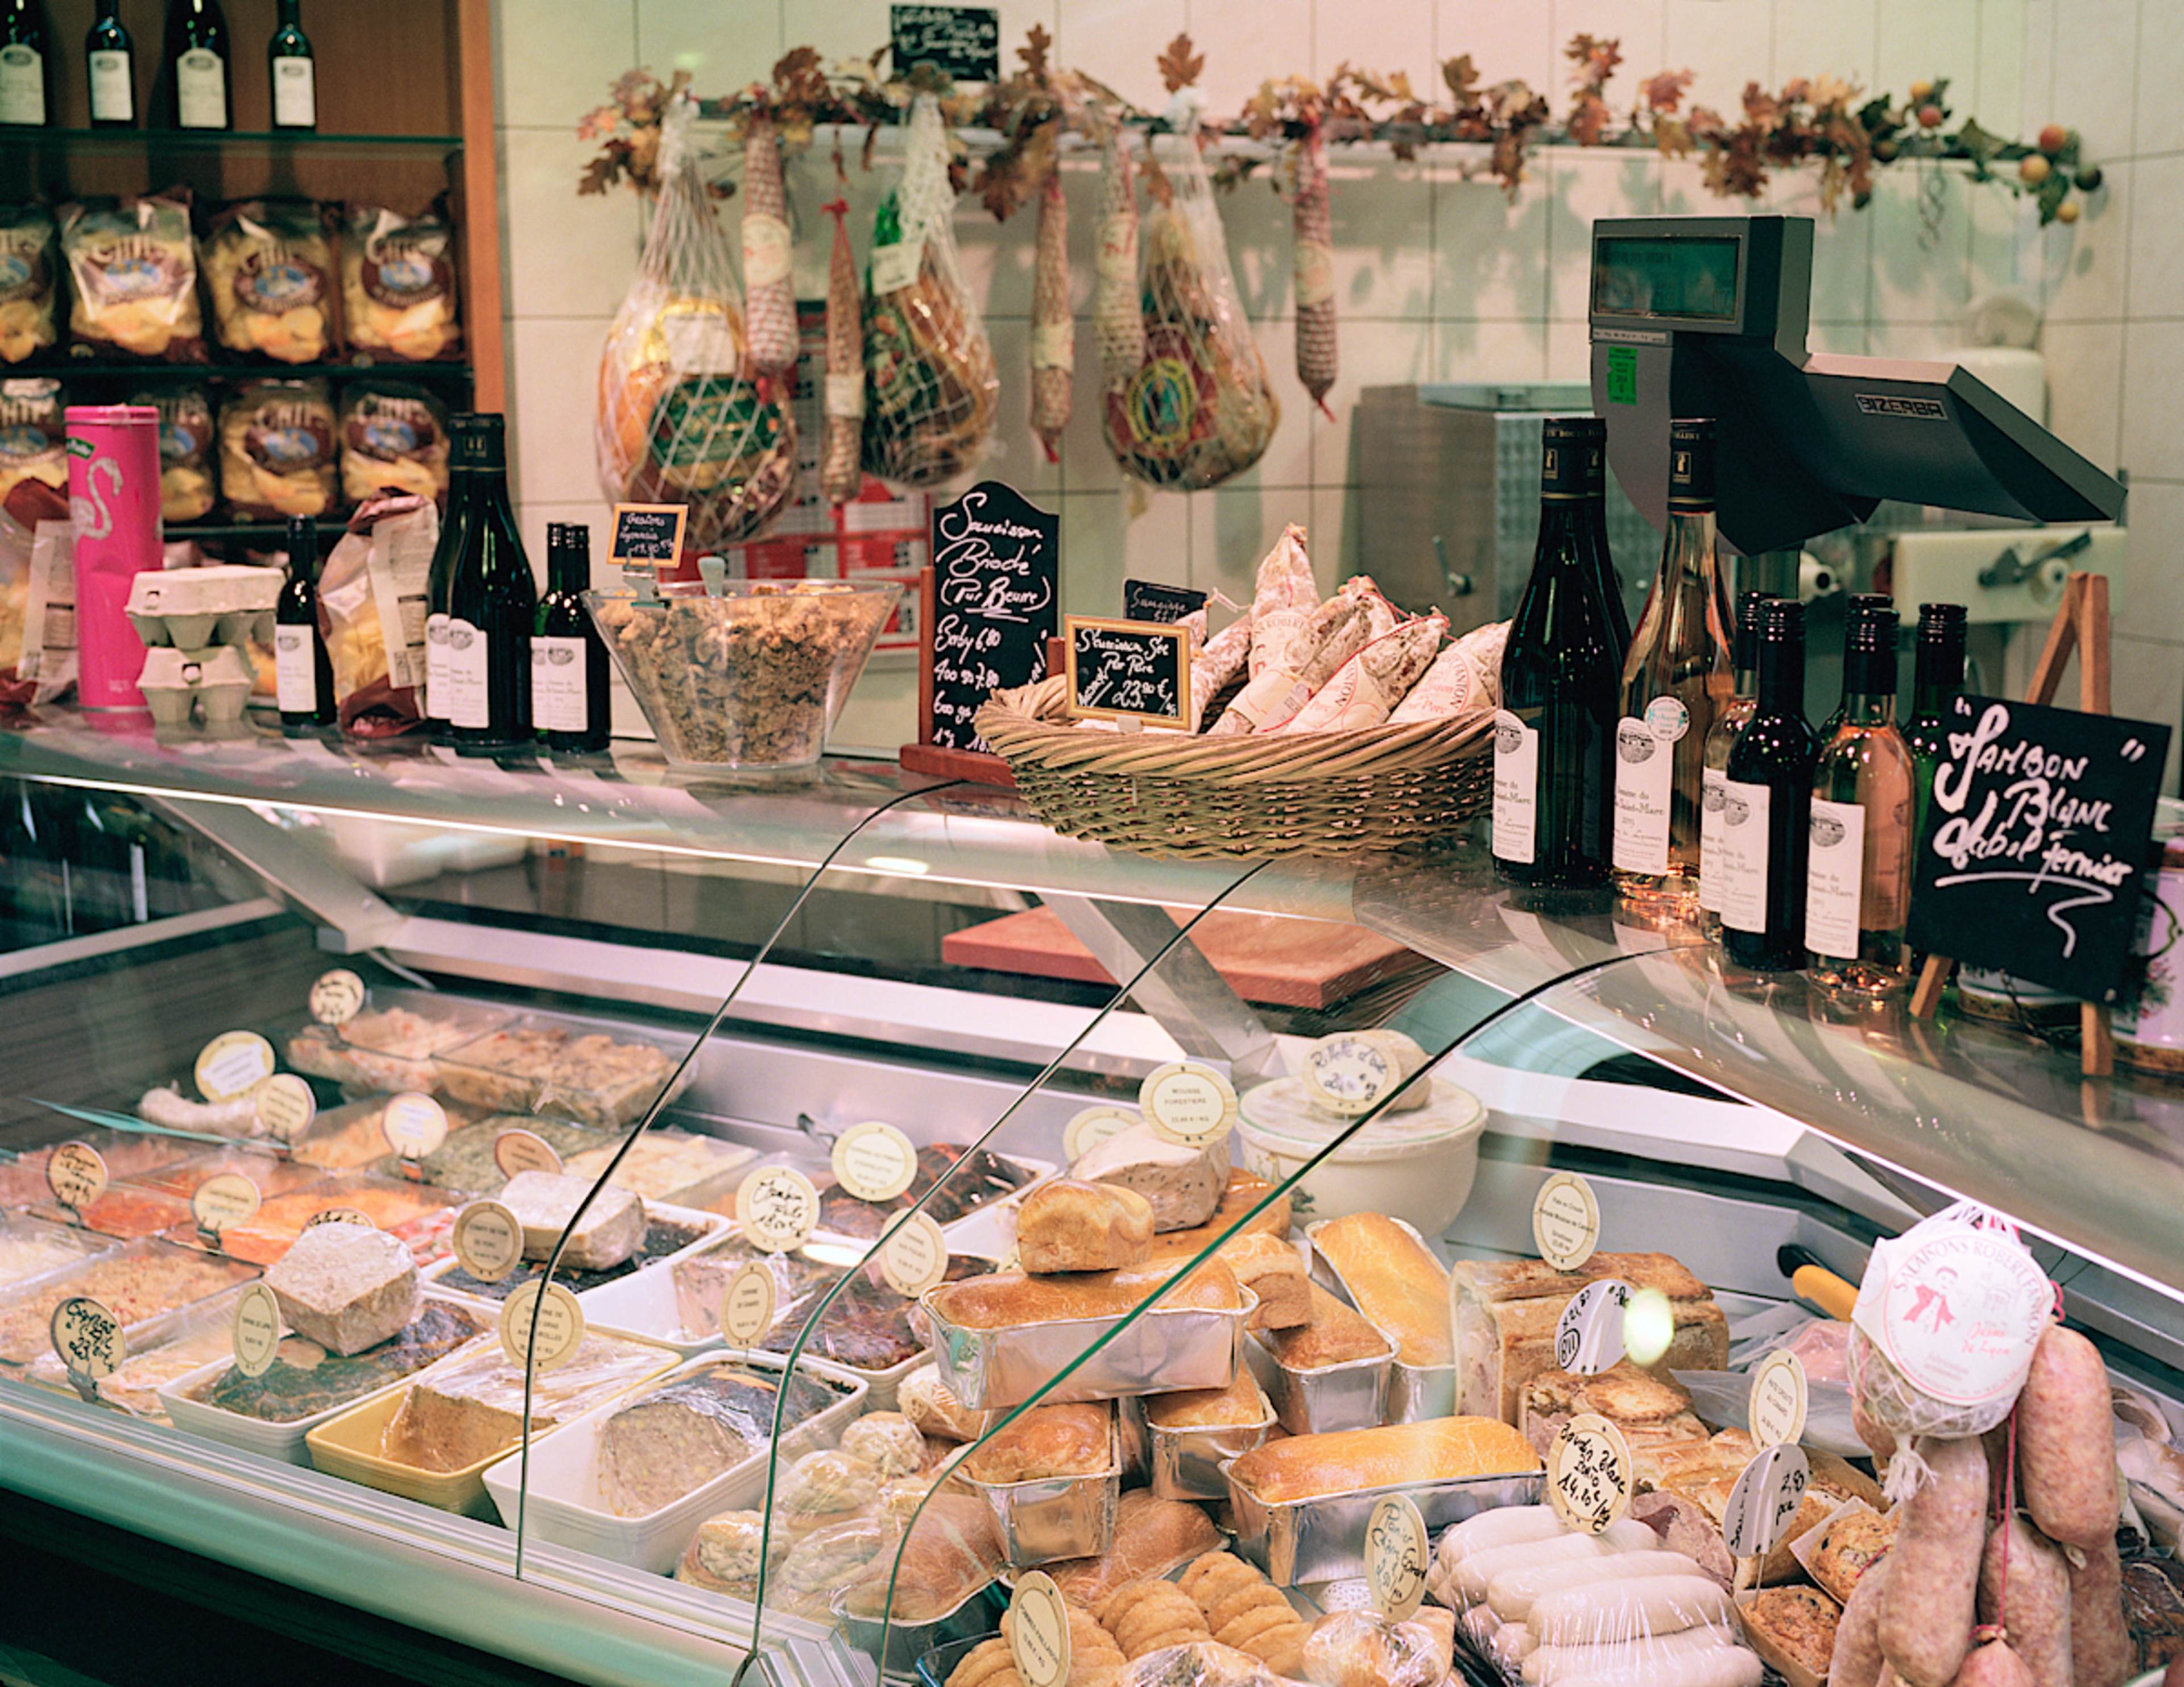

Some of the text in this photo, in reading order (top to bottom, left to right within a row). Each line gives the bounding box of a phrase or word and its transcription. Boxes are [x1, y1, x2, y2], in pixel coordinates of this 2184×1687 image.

[1858, 396, 1945, 417] BIZERBA
[934, 613, 974, 665] Baby
[934, 657, 958, 681] 400
[933, 689, 954, 714] 600
